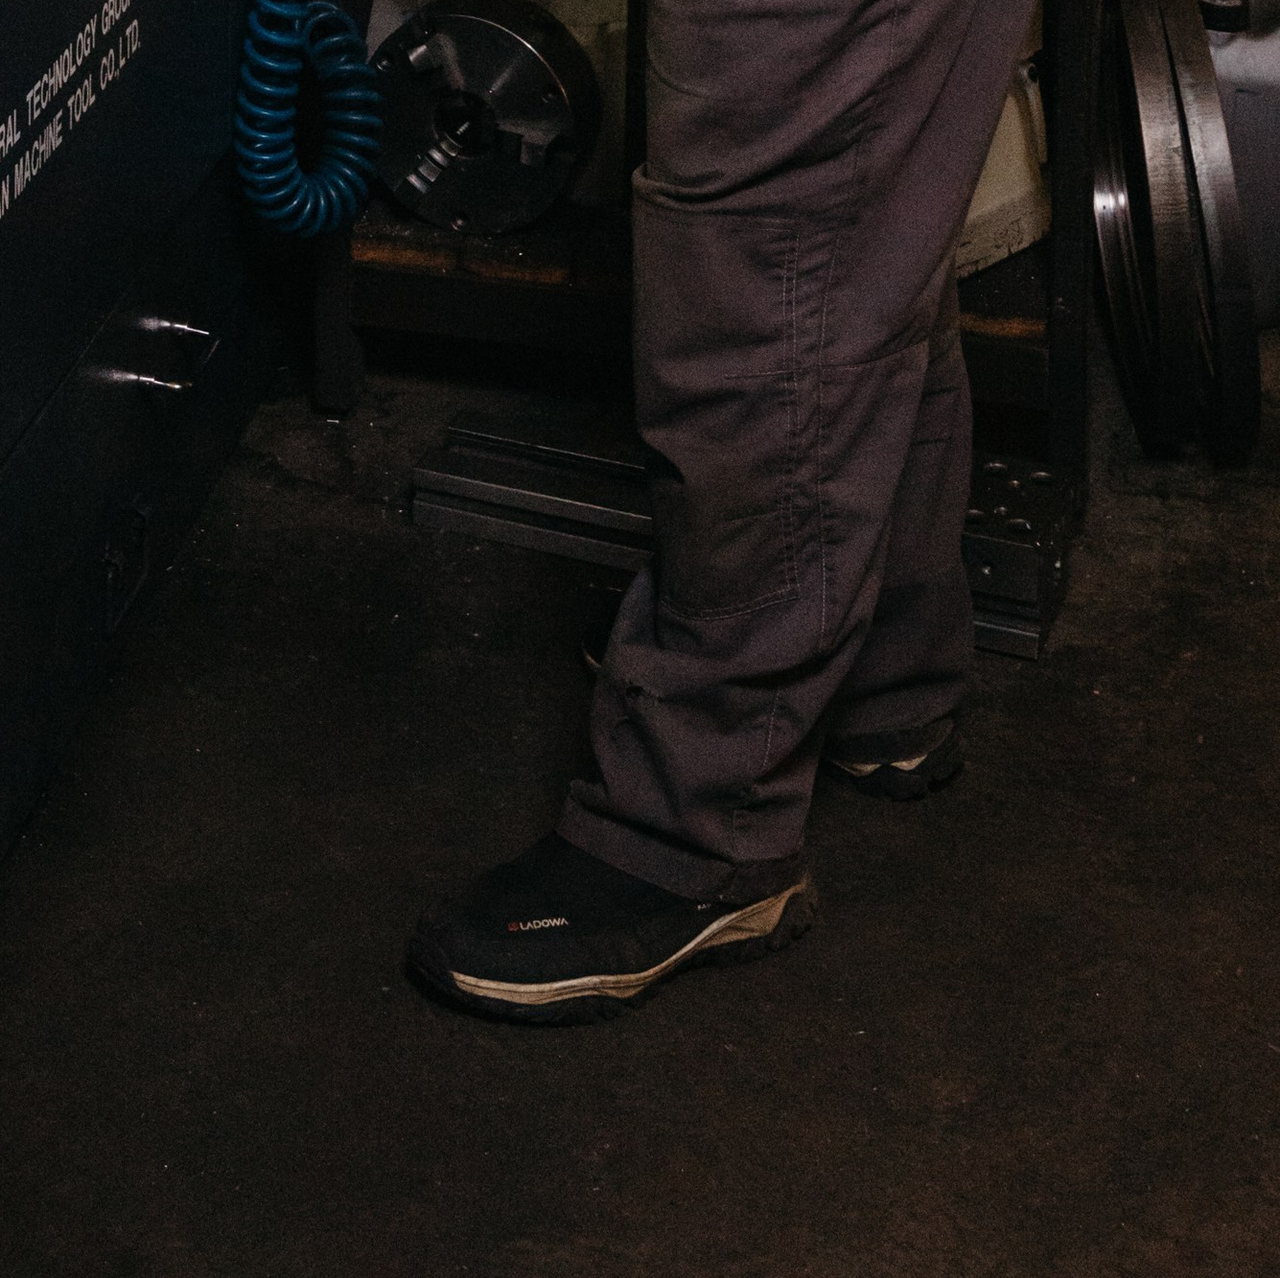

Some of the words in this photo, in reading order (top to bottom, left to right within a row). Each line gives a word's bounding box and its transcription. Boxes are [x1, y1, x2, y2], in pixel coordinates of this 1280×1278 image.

[26, 13, 98, 126] TECHNOLOGY
[14, 108, 63, 200] MACHINE
[67, 73, 96, 130] TOOL
